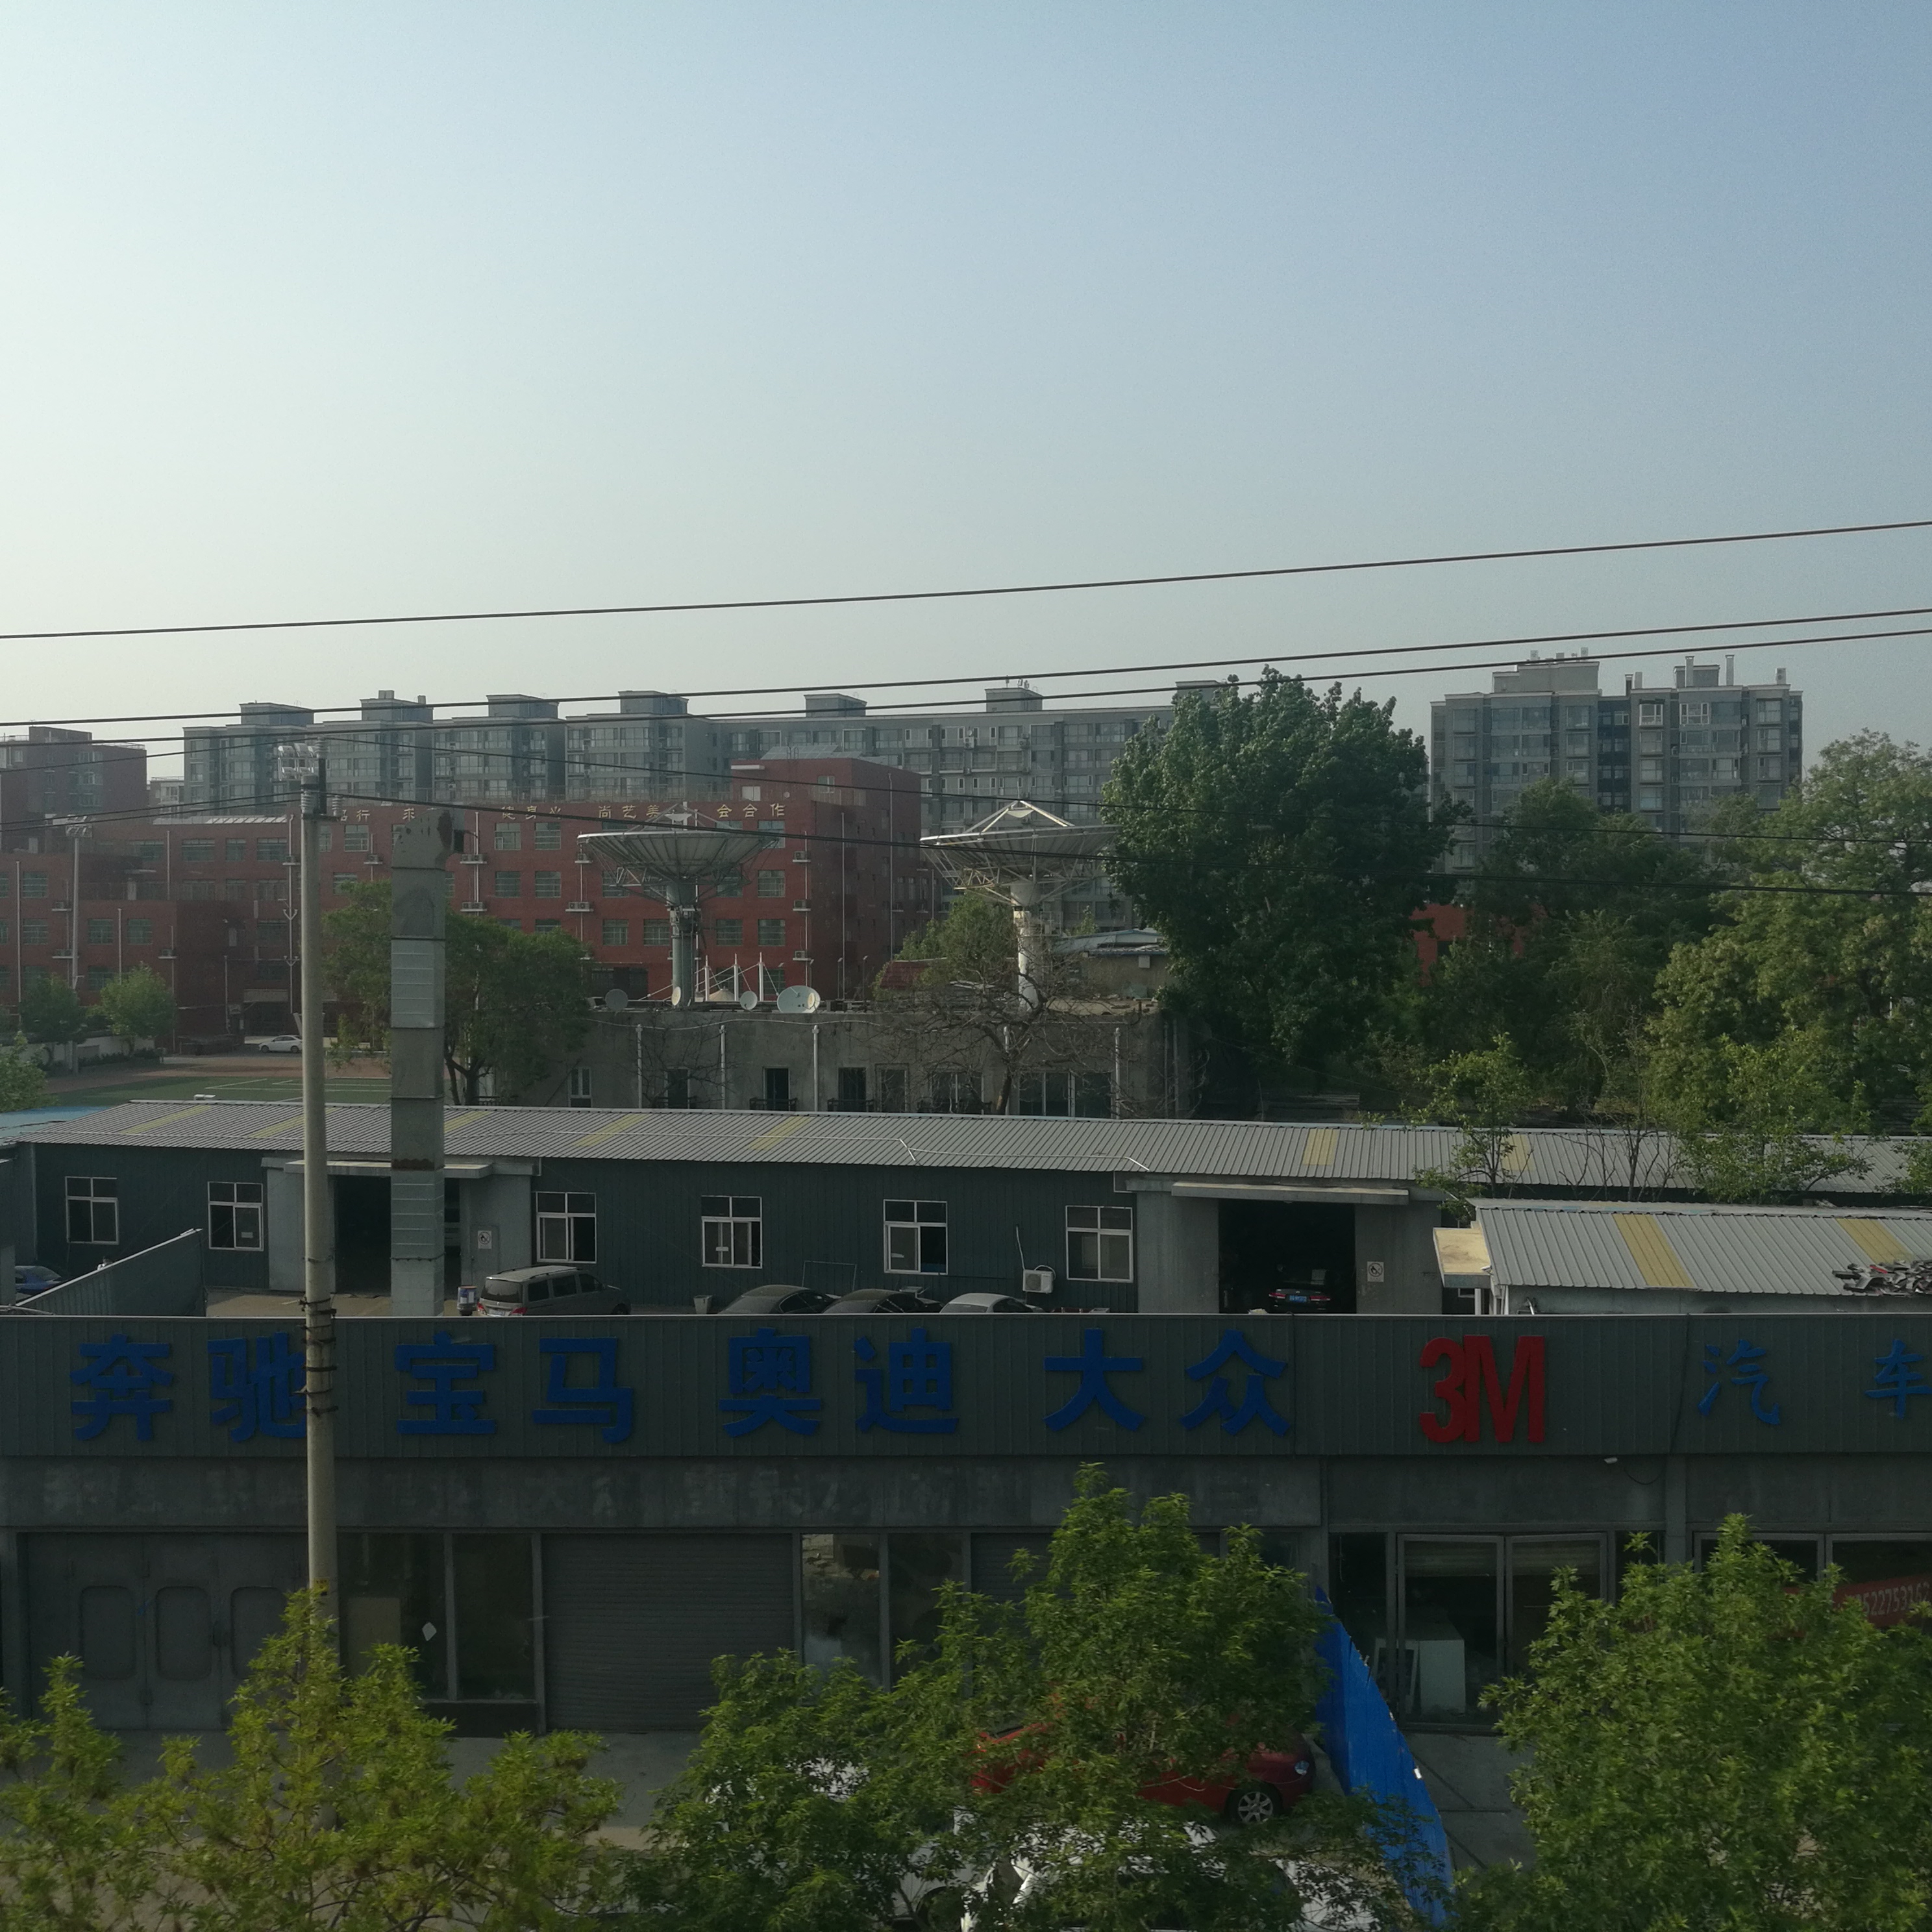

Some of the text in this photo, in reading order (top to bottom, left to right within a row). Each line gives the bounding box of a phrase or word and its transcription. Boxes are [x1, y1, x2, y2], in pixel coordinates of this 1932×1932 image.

[717, 803, 786, 819] 会合作
[69, 1327, 1291, 1444] 奔驰 宝马 奥迪 大众
[1418, 1334, 1546, 1443] 3M
